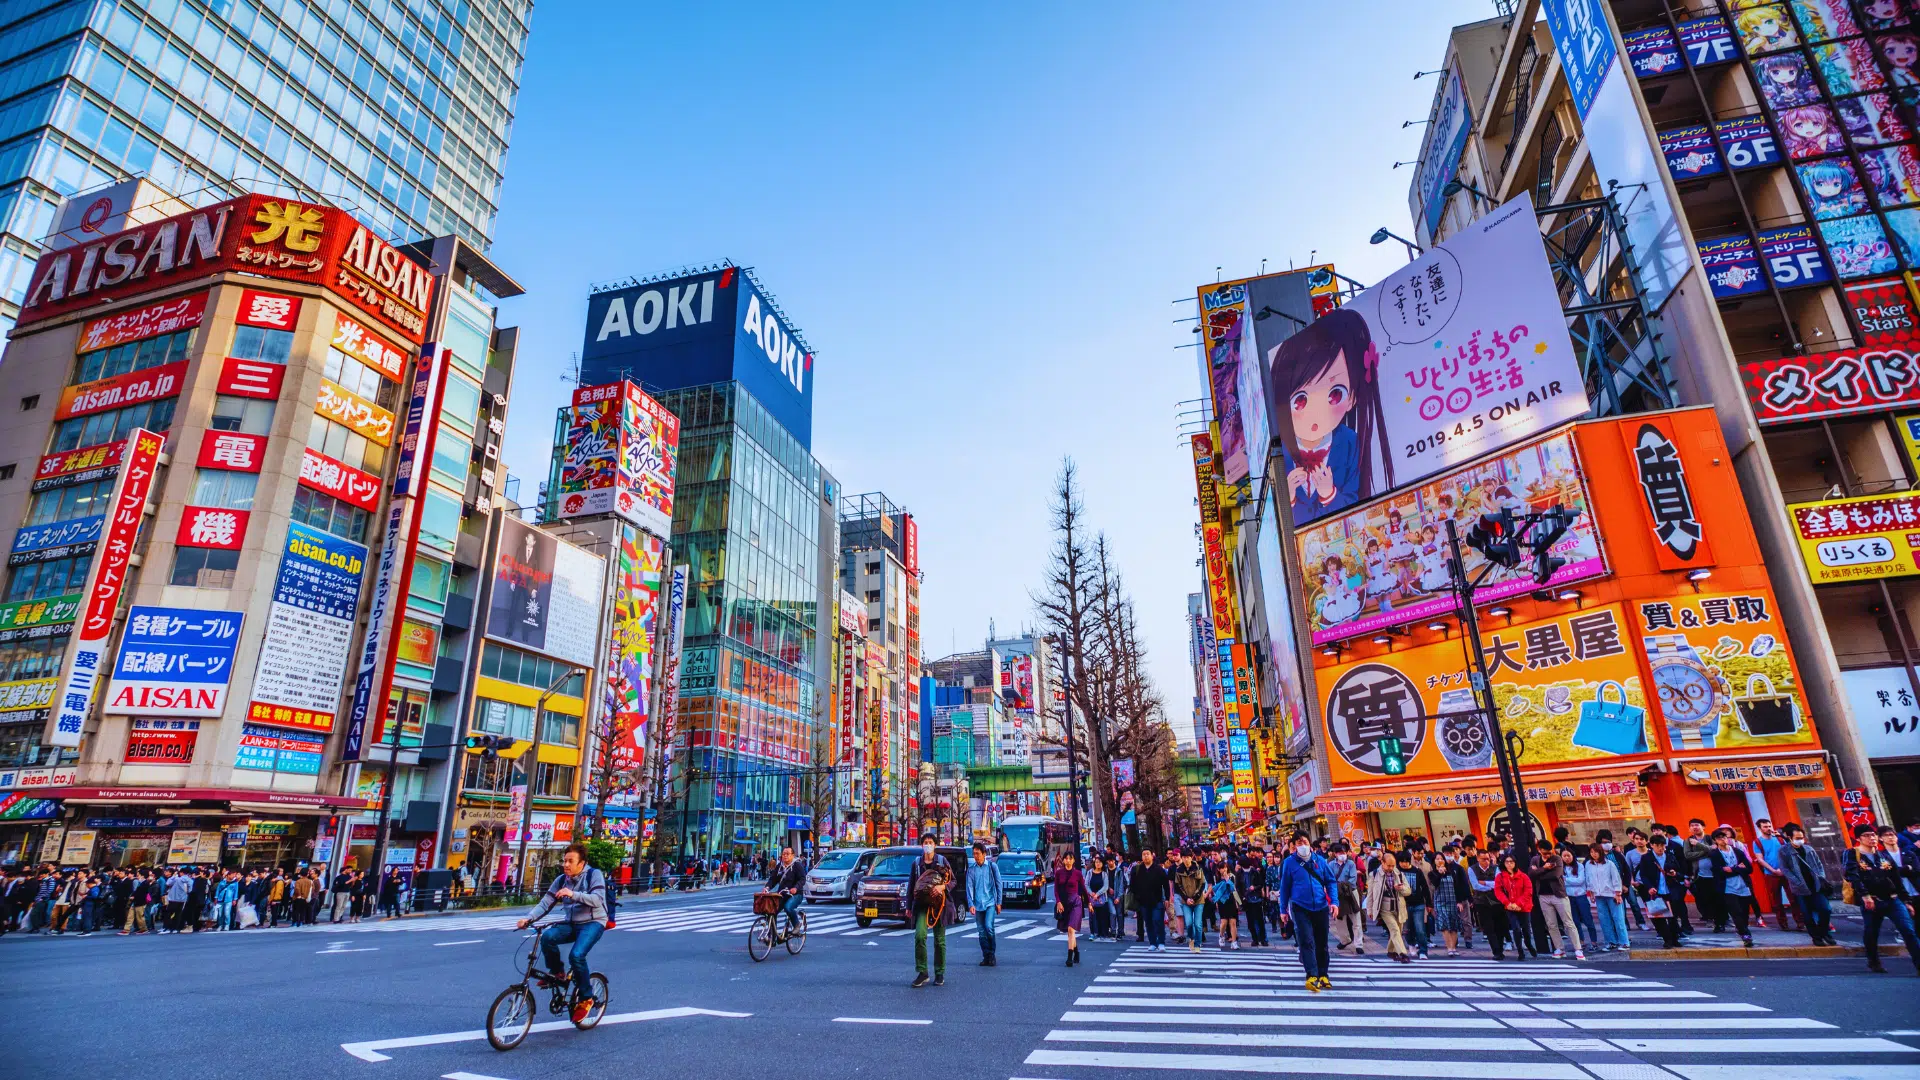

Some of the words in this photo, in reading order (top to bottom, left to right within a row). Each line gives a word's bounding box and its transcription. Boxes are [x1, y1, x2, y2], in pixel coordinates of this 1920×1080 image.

[1687, 37, 1735, 66] 7F
[1726, 137, 1777, 167] 6F
[250, 201, 325, 254] 光
[1488, 207, 1524, 231] KADOKAWA
[25, 206, 234, 309] AISAN
[237, 246, 325, 273] ネットワーク
[343, 226, 432, 315] AISAN
[1772, 253, 1824, 283] 5F
[1426, 262, 1447, 305] 友達に
[596, 279, 715, 342] AOKI
[1410, 275, 1431, 327] なりたい
[1861, 314, 1913, 333] Stars
[333, 321, 404, 377] 光通信
[743, 293, 804, 394] AOKI
[1405, 325, 1530, 393] ひとりぼっちの
[70, 373, 174, 413] aisan.co.jp
[579, 385, 619, 404] 免税店
[1768, 354, 1920, 406] メイド
[317, 385, 395, 438] ネットワーク
[1405, 414, 1485, 459] 2019.4.5
[1488, 398, 1523, 422] ON
[1526, 381, 1564, 408] AIR
[398, 379, 429, 482] 愛三電機
[41, 457, 61, 475] 3F
[300, 453, 381, 502] 配線パーツ
[1198, 465, 1212, 473] DVD
[17, 530, 38, 549] 2F
[39, 517, 104, 547] ネットワーク
[88, 437, 158, 630] 光・ケーブル・ネットワーク
[1804, 502, 1920, 537] 全身もみほ
[289, 538, 363, 576] aisan.co.jp
[1824, 542, 1888, 566] りらくる
[1820, 564, 1907, 582] 秋葉原中央通り店
[674, 569, 685, 612] AKKY
[131, 614, 235, 640] 各種ケーブル
[1484, 610, 1625, 679] 大黒屋
[121, 650, 227, 675] 配線パーツ
[685, 665, 709, 675] OPEN
[58, 650, 100, 734] 愛三電機
[111, 686, 219, 710] AISAN
[1209, 661, 1222, 708] Tax-free
[1236, 666, 1250, 705] 吉野家
[1877, 687, 1913, 708] 喫茶
[347, 675, 370, 752] AISAN
[1213, 709, 1225, 739] Shop
[127, 740, 195, 759] aisan.co.jp
[1231, 745, 1248, 753] DVD
[1713, 763, 1822, 780] 1階にて高価買取中
[1579, 780, 1638, 798] 無料査定
[1843, 791, 1863, 804] 4F
[131, 817, 153, 826] 1949
[468, 811, 482, 819] Cafe
[556, 820, 571, 831] au
